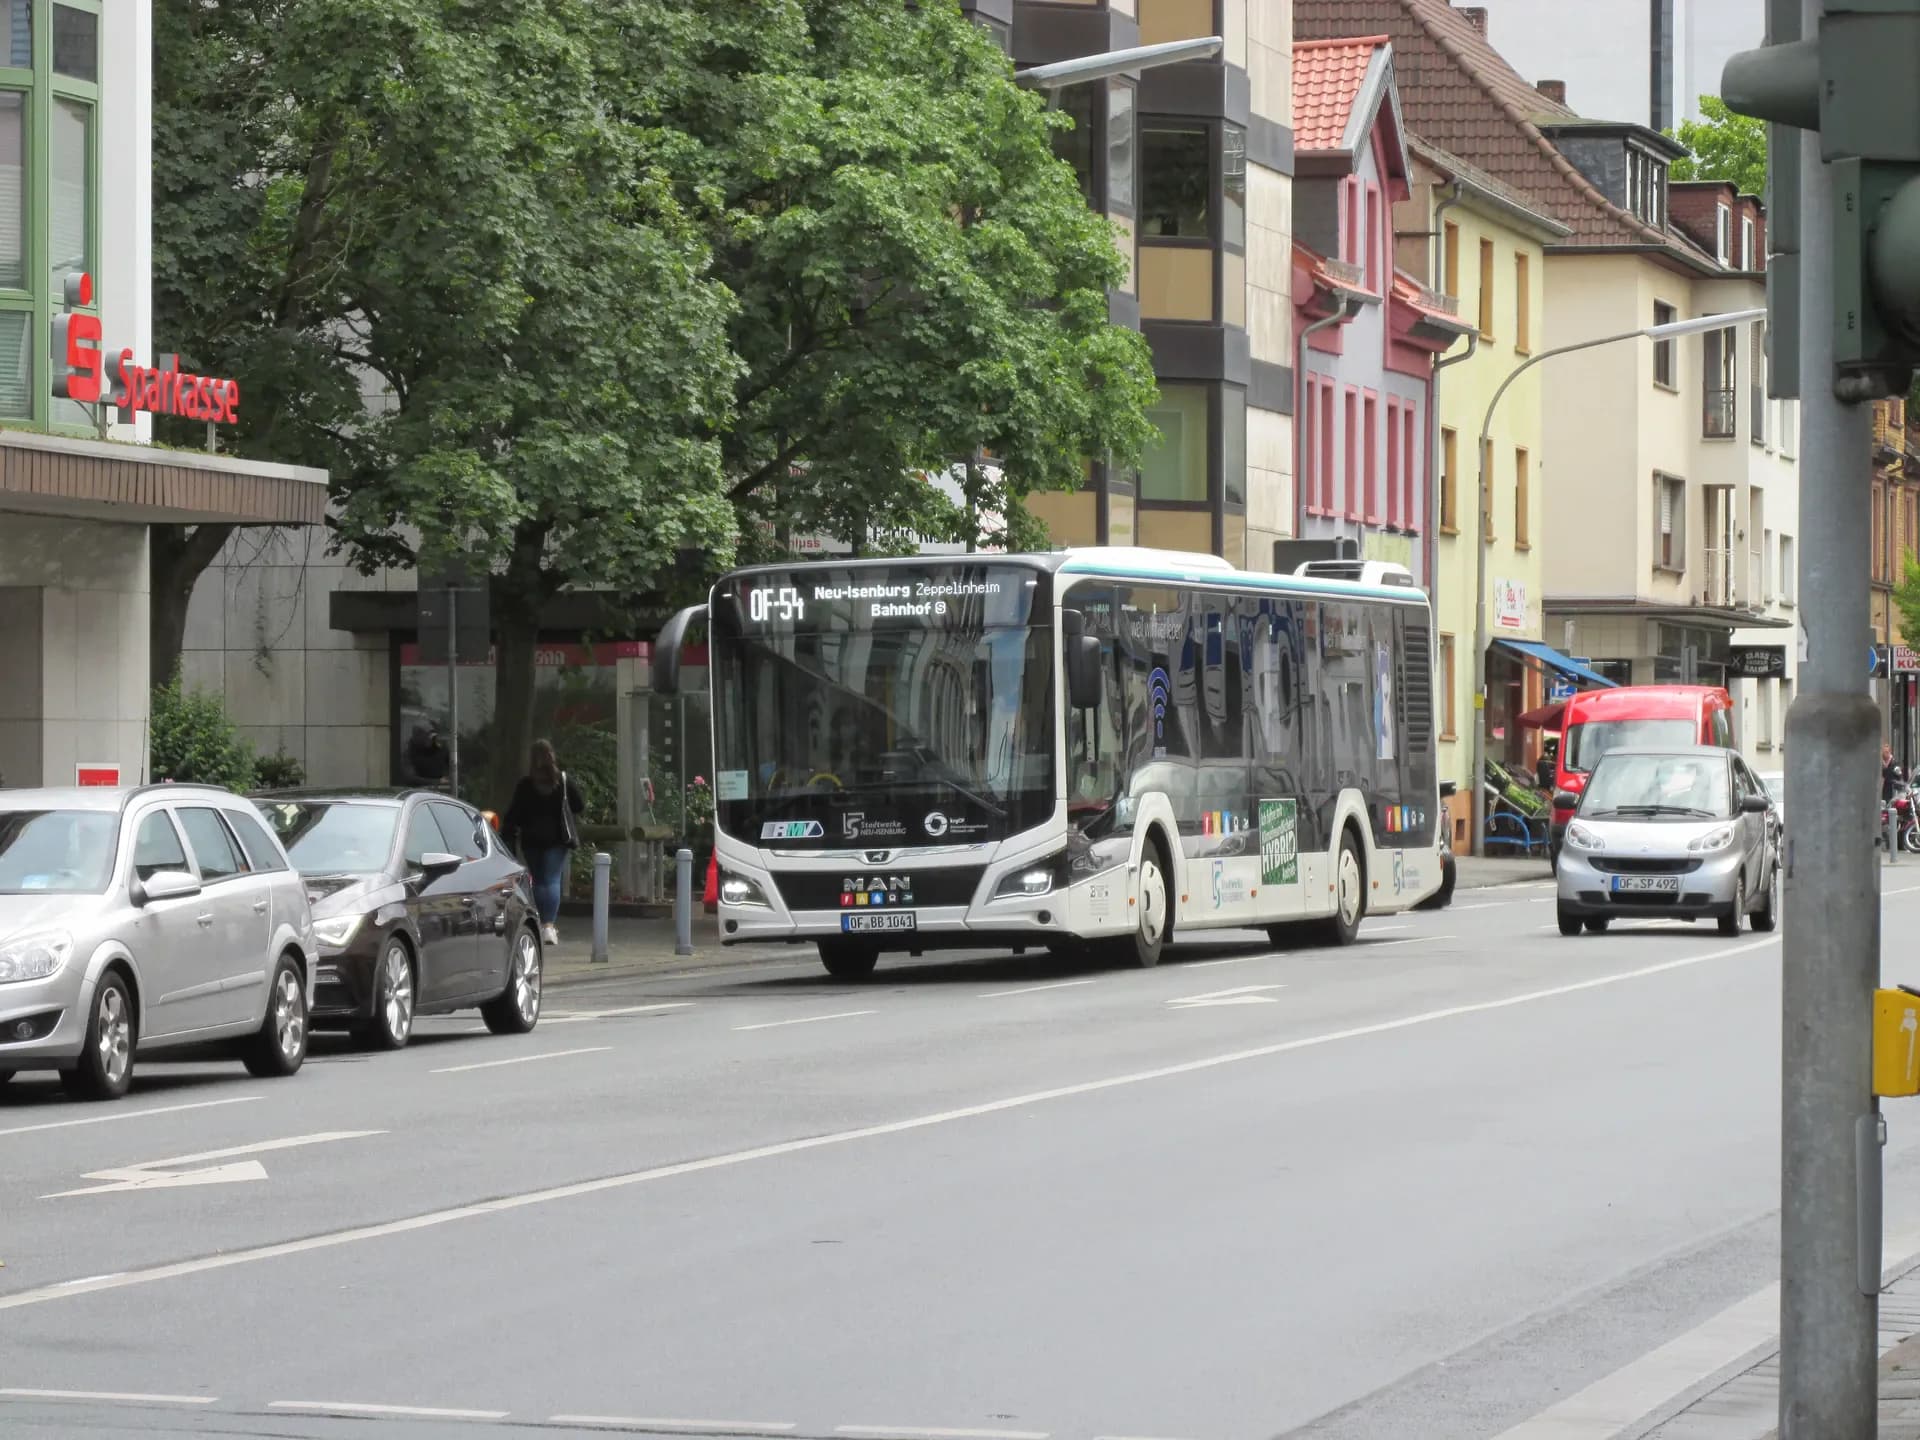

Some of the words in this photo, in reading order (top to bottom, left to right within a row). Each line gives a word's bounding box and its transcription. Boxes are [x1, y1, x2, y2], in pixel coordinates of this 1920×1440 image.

[115, 348, 240, 425] Sparkasse
[814, 584, 911, 600] Neu-Isenburg
[915, 581, 1000, 597] Zeppelinheim
[750, 587, 805, 621] OF-54
[871, 602, 932, 617] Bahnhof
[860, 820, 901, 829] Stadtwerke
[1262, 830, 1296, 875] HYBRID
[843, 876, 911, 892] MAN
[1620, 878, 1632, 889] OF
[1640, 878, 1654, 889] SP
[1656, 878, 1676, 889] 492
[850, 916, 863, 929] OF
[870, 916, 884, 929] BB
[886, 915, 913, 928] 1041
